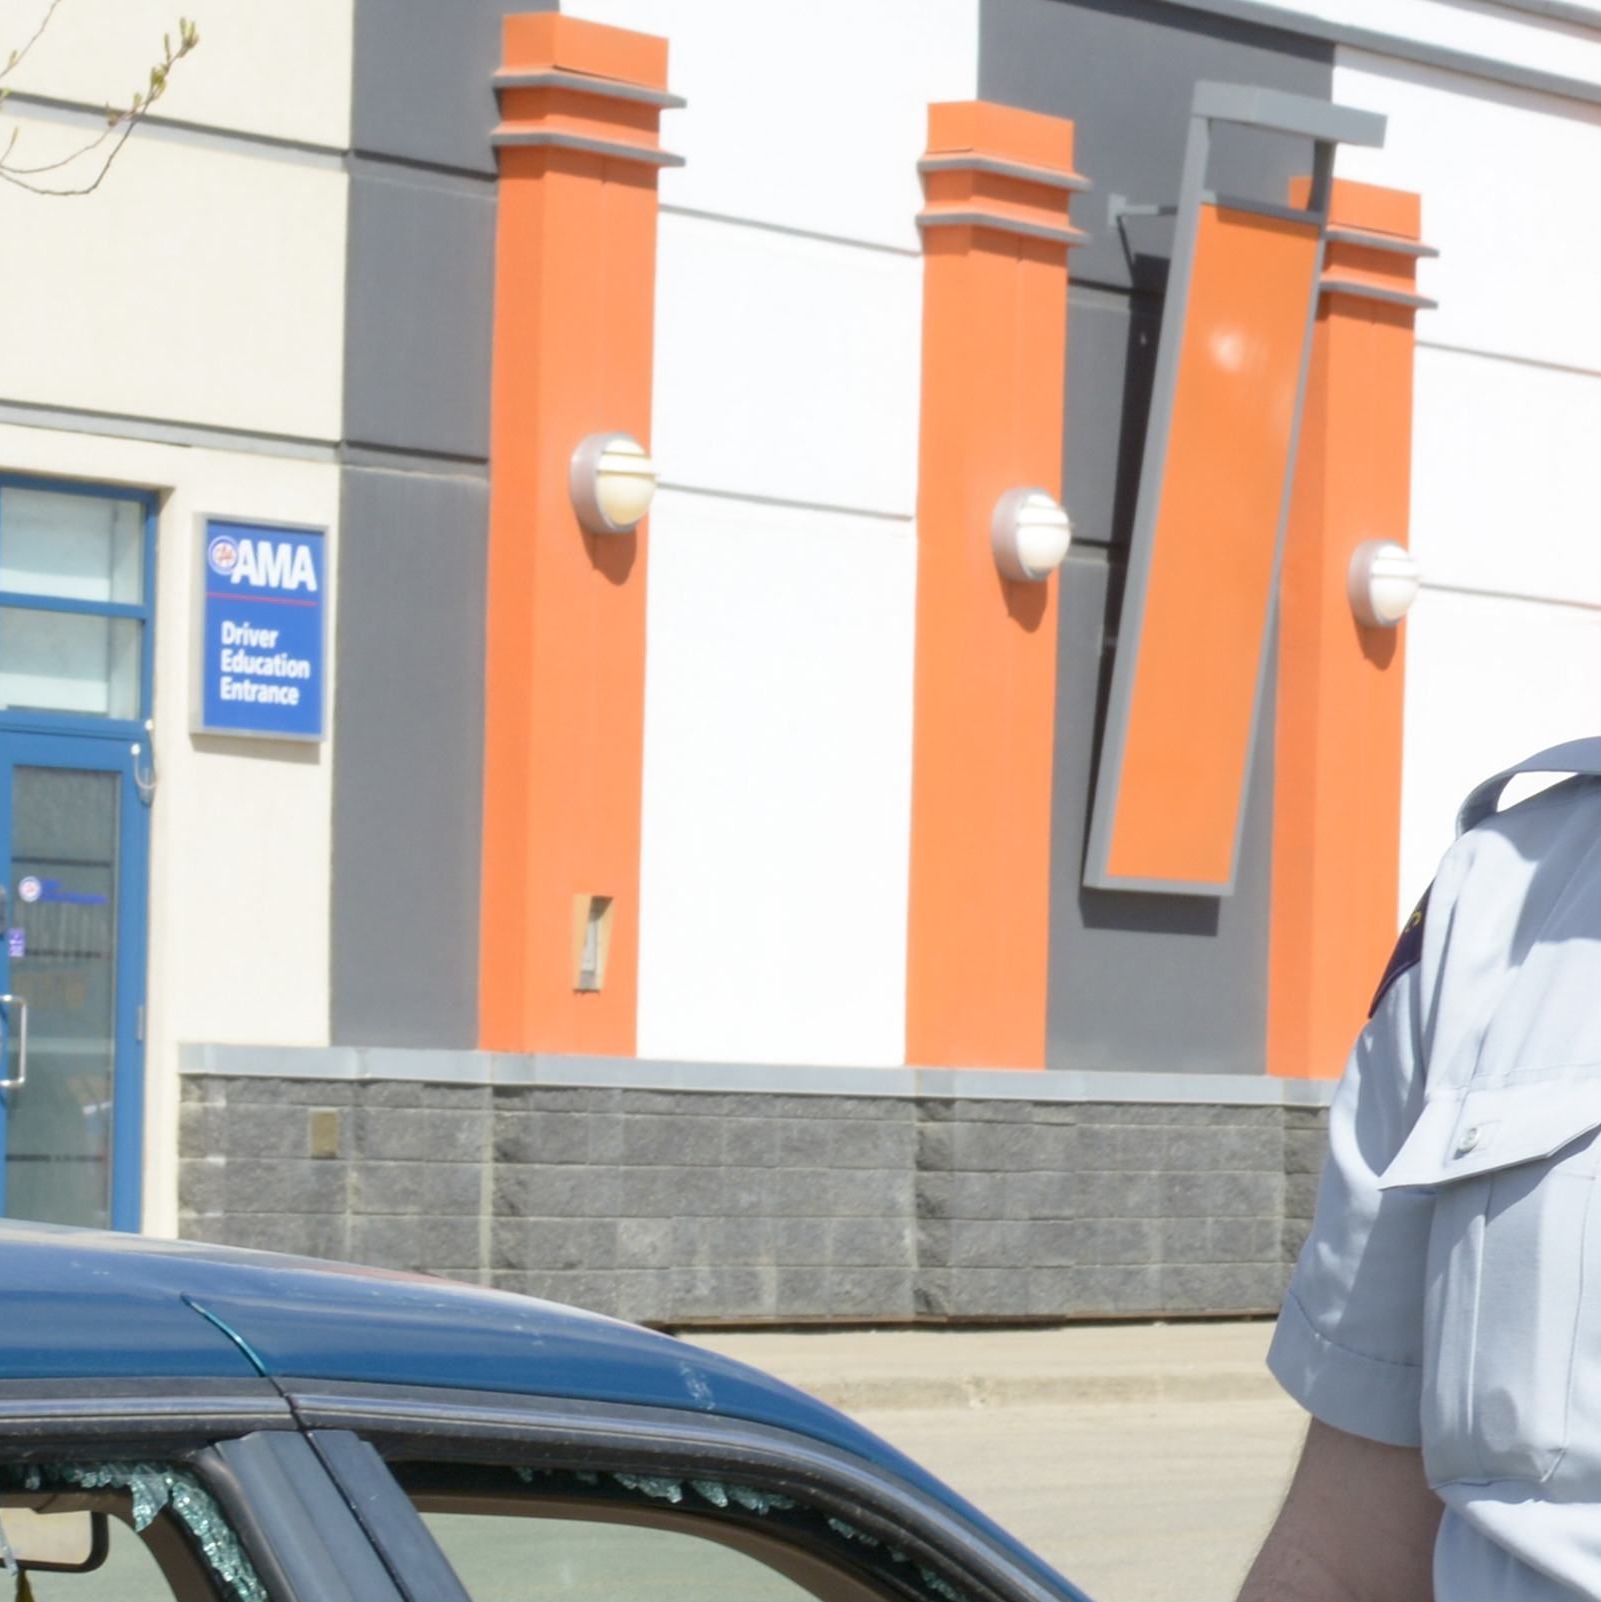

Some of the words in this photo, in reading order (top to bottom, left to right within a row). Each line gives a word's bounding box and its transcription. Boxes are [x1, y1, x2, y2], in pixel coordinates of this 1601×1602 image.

[230, 538, 317, 591] AMA
[220, 620, 278, 649] Driver
[220, 648, 310, 679] Education
[220, 677, 300, 705] Entrance
